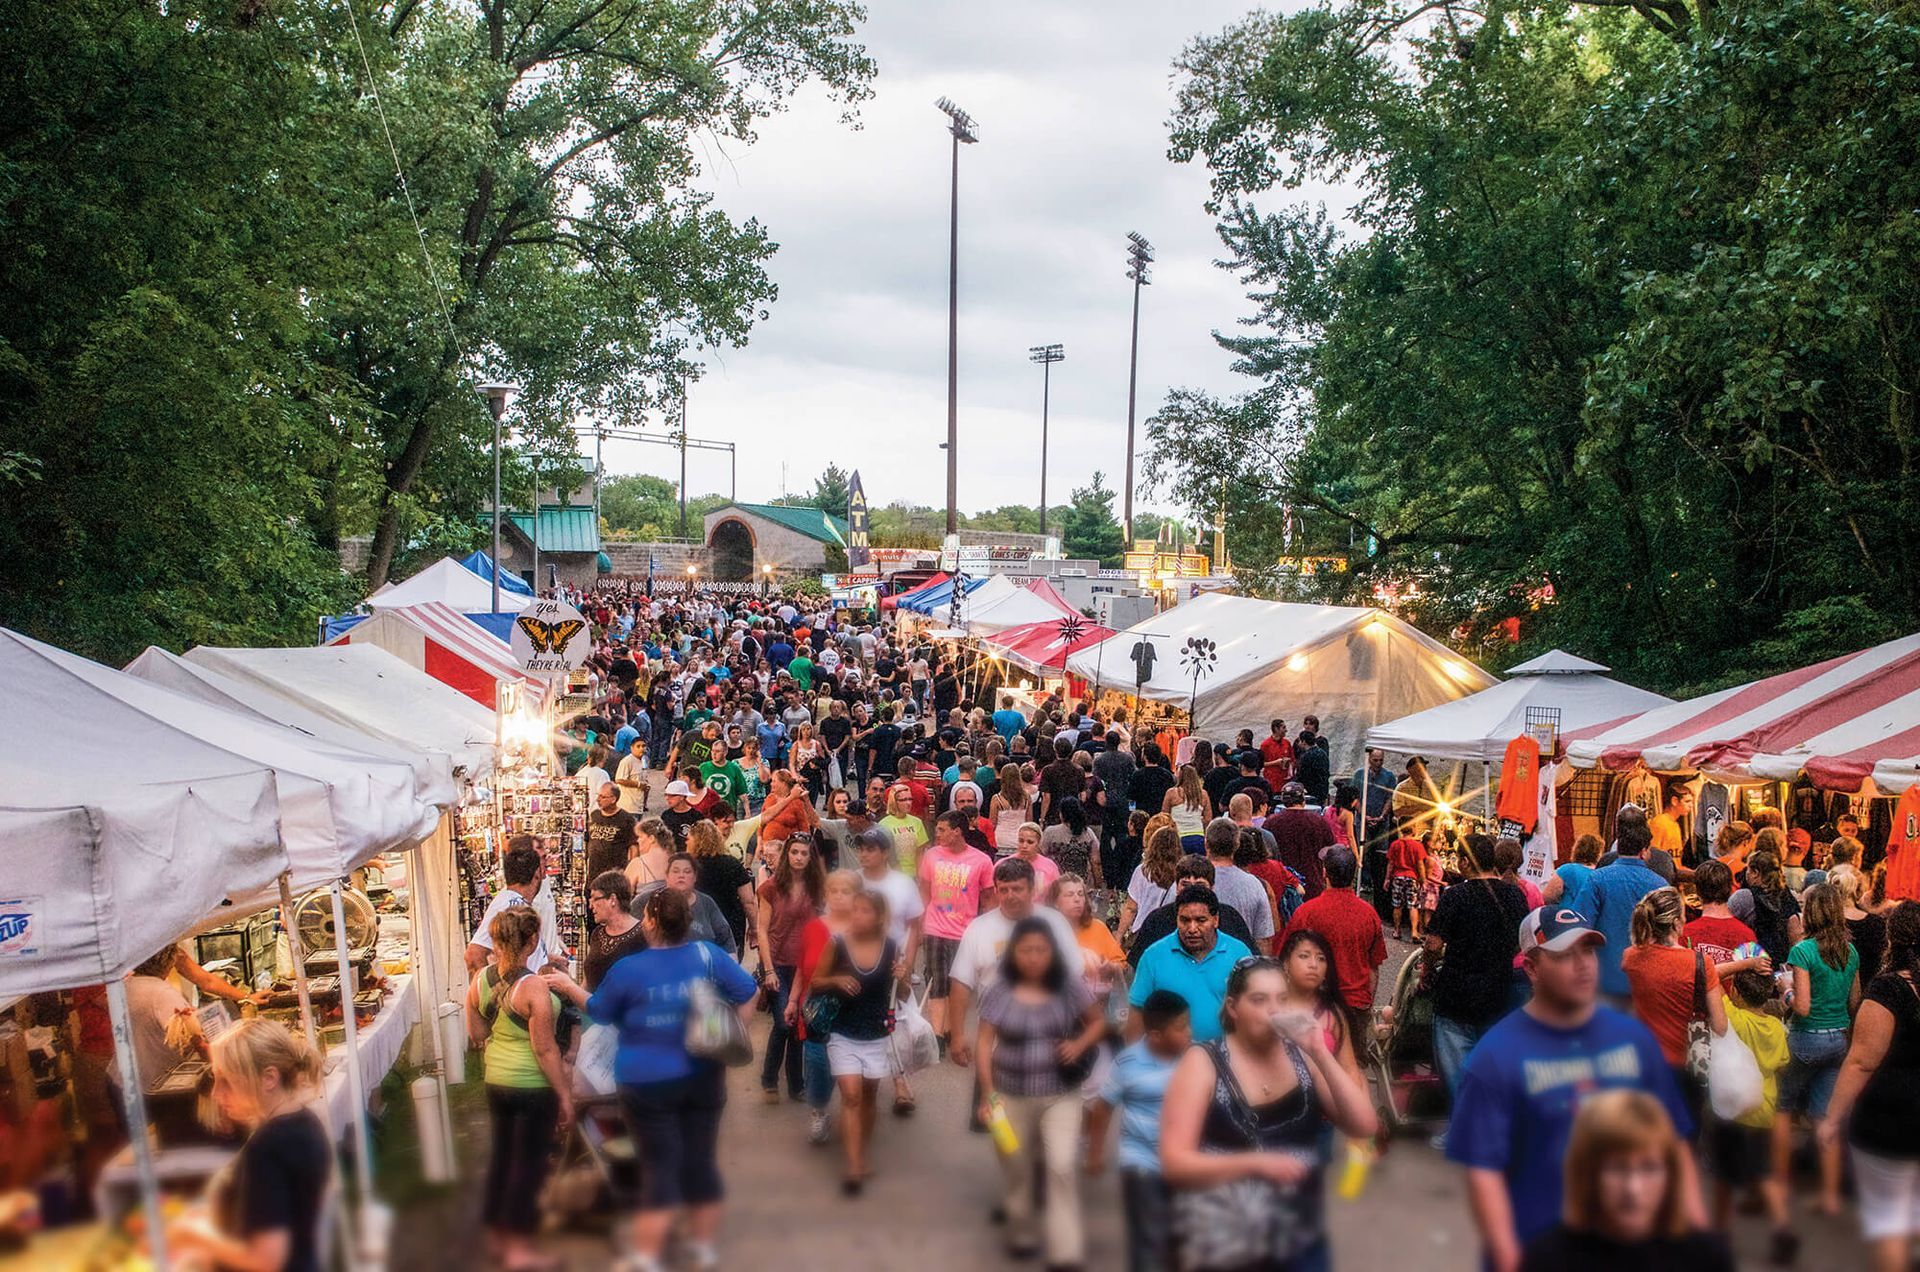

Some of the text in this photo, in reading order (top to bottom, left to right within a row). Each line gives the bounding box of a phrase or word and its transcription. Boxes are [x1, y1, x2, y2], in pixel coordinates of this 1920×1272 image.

[850, 489, 868, 547] ATM
[1013, 551, 1029, 559] CUPS
[535, 601, 560, 618] Yes
